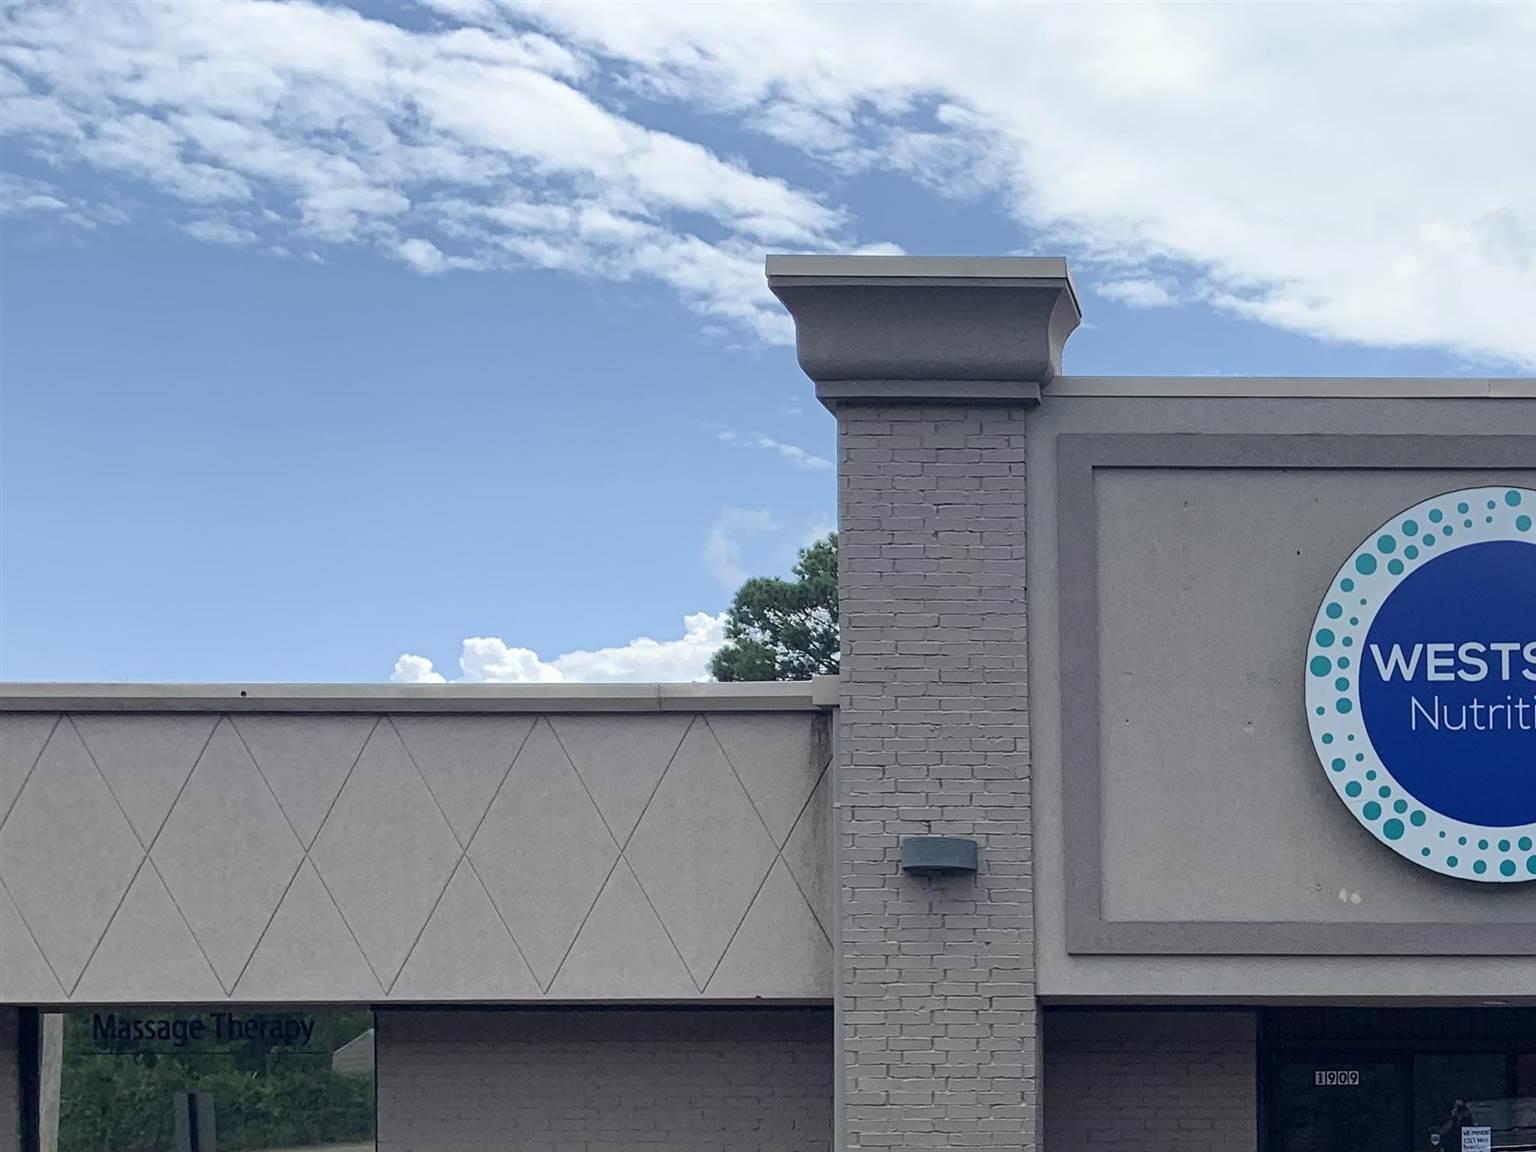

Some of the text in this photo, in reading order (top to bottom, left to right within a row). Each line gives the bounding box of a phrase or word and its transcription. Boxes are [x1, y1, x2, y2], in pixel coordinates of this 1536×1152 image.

[93, 1013, 315, 1046] Massage Therapy
[1316, 1071, 1359, 1084] 1909
